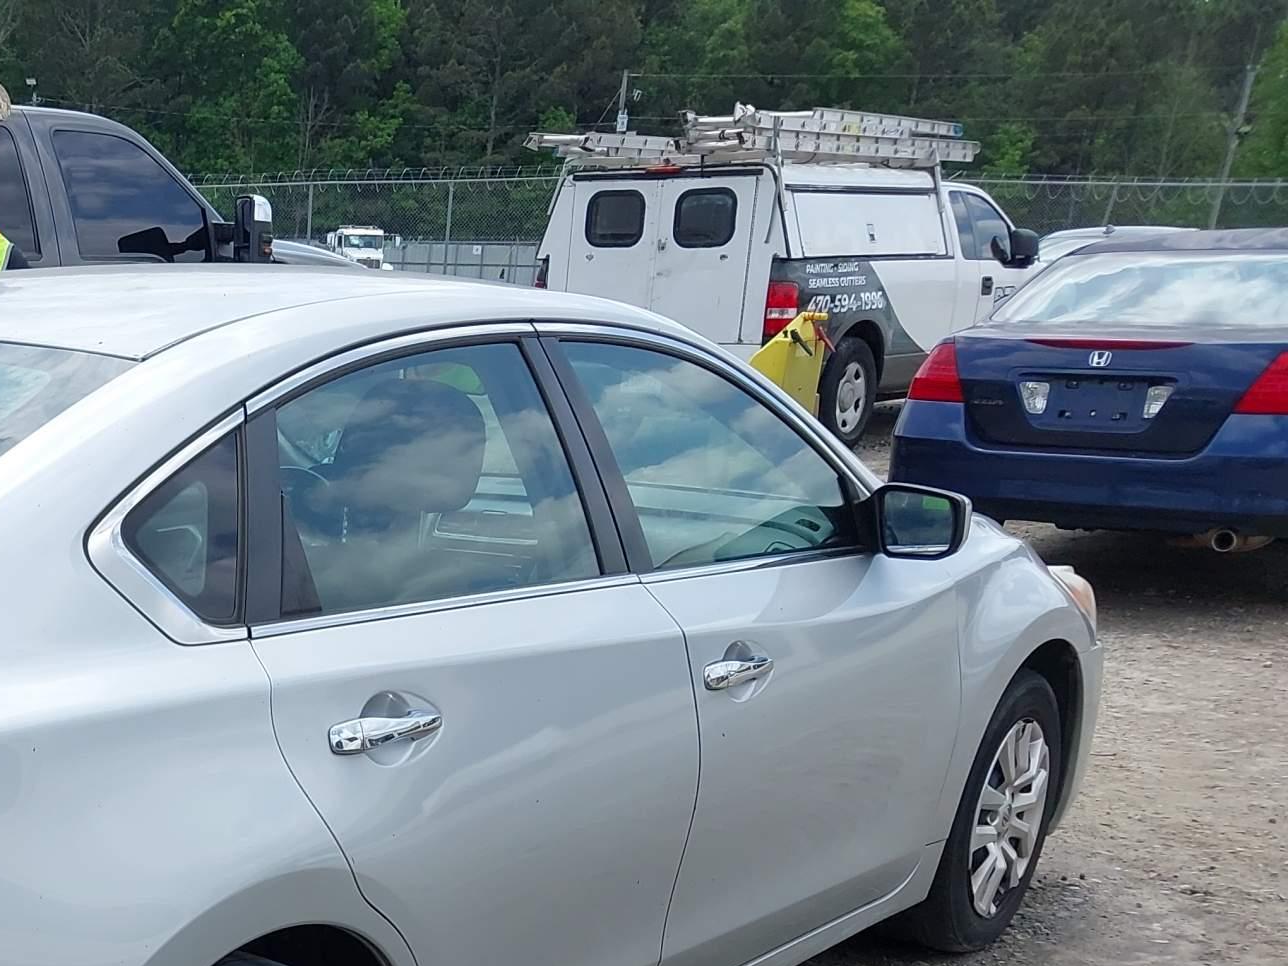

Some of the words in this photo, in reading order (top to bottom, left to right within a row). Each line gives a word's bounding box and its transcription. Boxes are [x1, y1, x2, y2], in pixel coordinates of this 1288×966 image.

[806, 263, 834, 273] PAINTING
[837, 262, 859, 273] SIDING
[808, 277, 839, 288] SEAMLESS
[840, 275, 866, 286] GUTTERS
